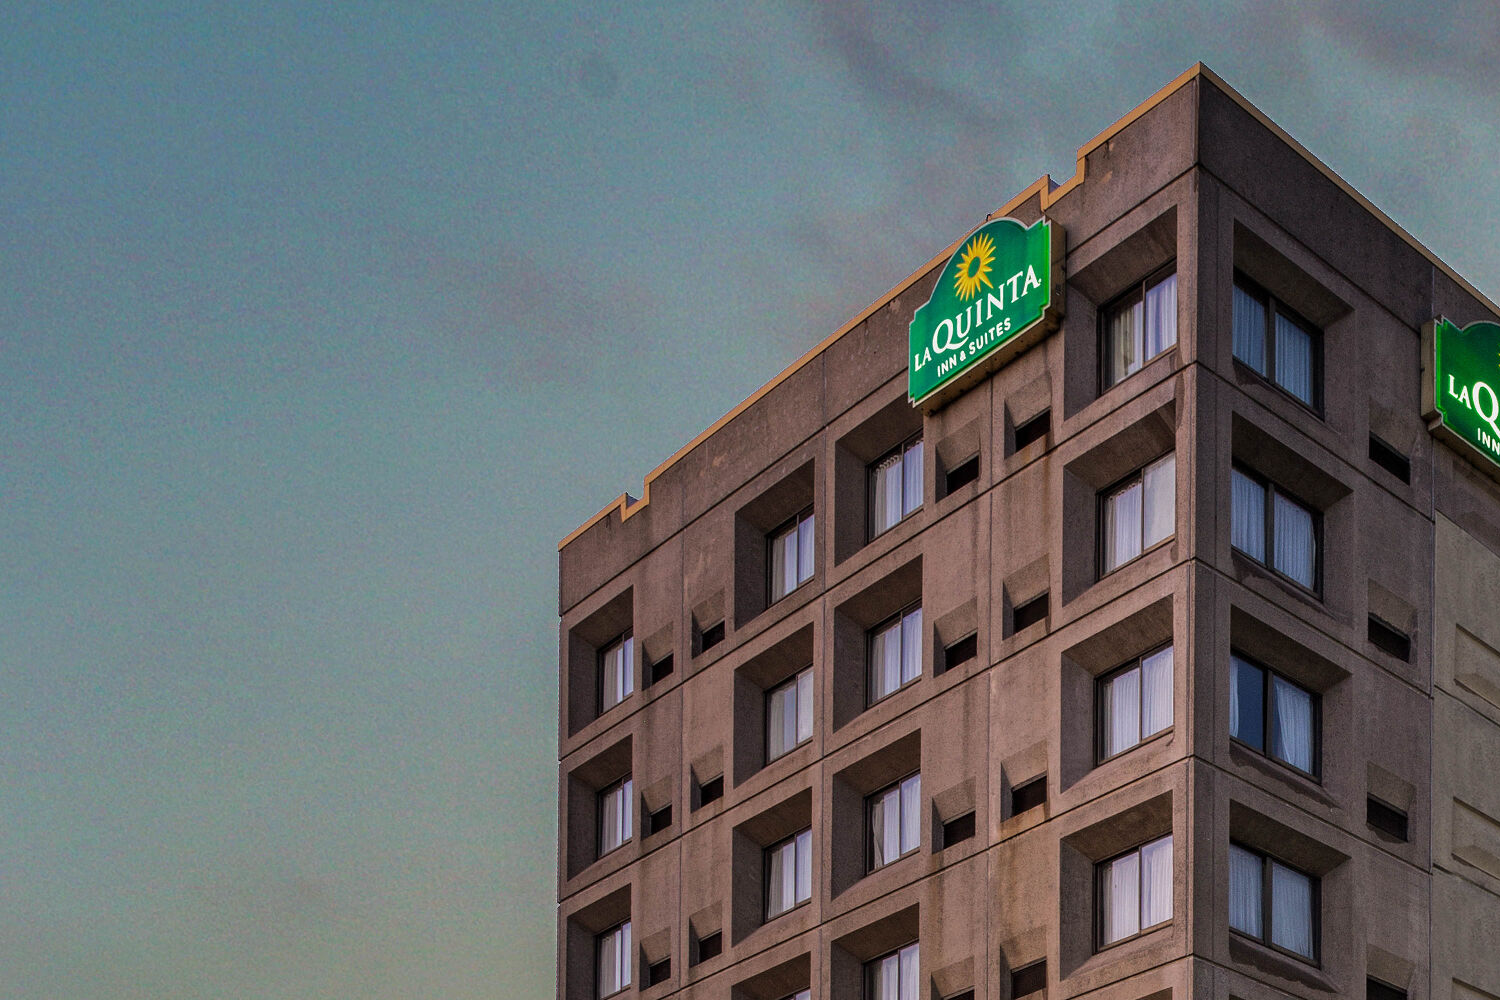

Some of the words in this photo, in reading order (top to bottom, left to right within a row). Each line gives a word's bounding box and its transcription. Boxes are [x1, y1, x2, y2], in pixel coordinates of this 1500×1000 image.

[915, 347, 932, 372] LA
[932, 264, 1041, 354] QUINTA
[937, 355, 957, 378] INN
[960, 352, 967, 362] &
[969, 317, 1011, 355] SUITES
[1448, 374, 1472, 410] LA
[1477, 428, 1500, 456] INN
